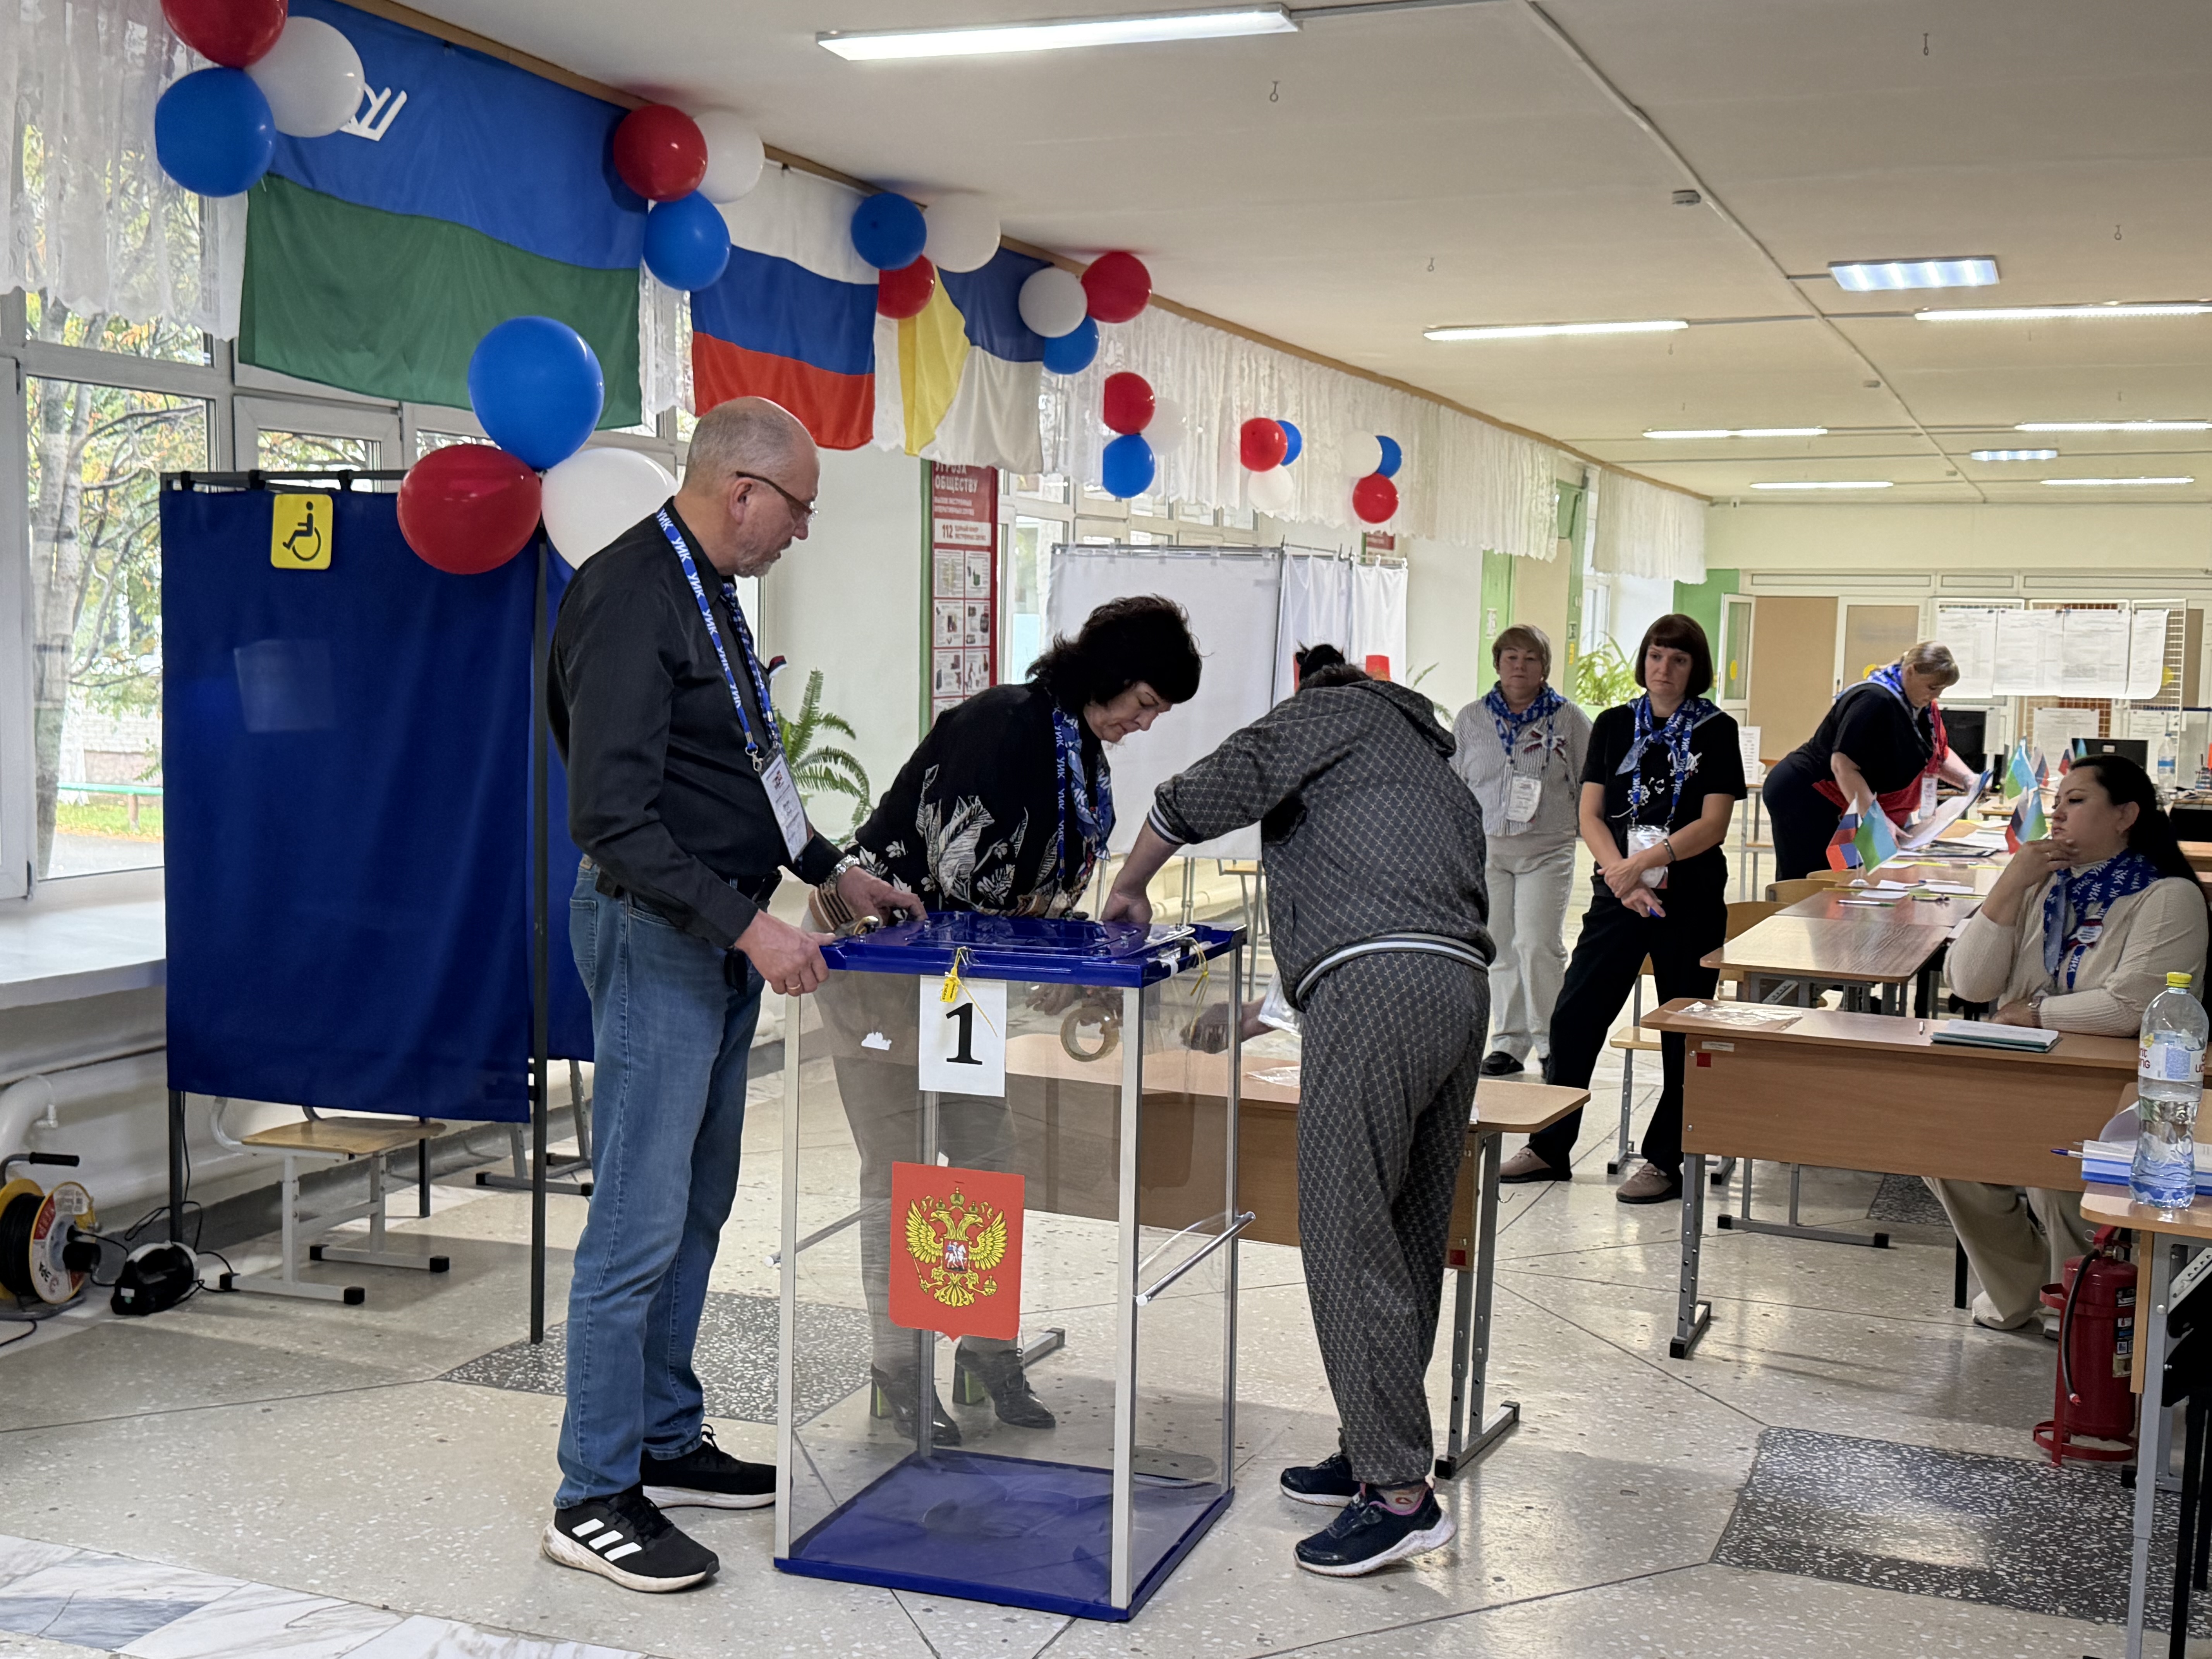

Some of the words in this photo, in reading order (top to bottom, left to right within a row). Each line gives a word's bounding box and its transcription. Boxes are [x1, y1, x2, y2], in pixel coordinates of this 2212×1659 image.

[935, 474, 978, 493] ОБЩЕСТВУ
[656, 508, 674, 531] УИК
[942, 524, 953, 539] 112
[671, 536, 692, 563] УИК
[687, 572, 705, 599] УИК
[702, 608, 718, 635] УИК
[717, 646, 730, 672] УИК
[1054, 725, 1064, 747] УИК
[1056, 756, 1065, 778] УИК
[2087, 881, 2103, 901] УИК
[2068, 954, 2081, 972] УИК
[945, 1002, 983, 1065] 1
